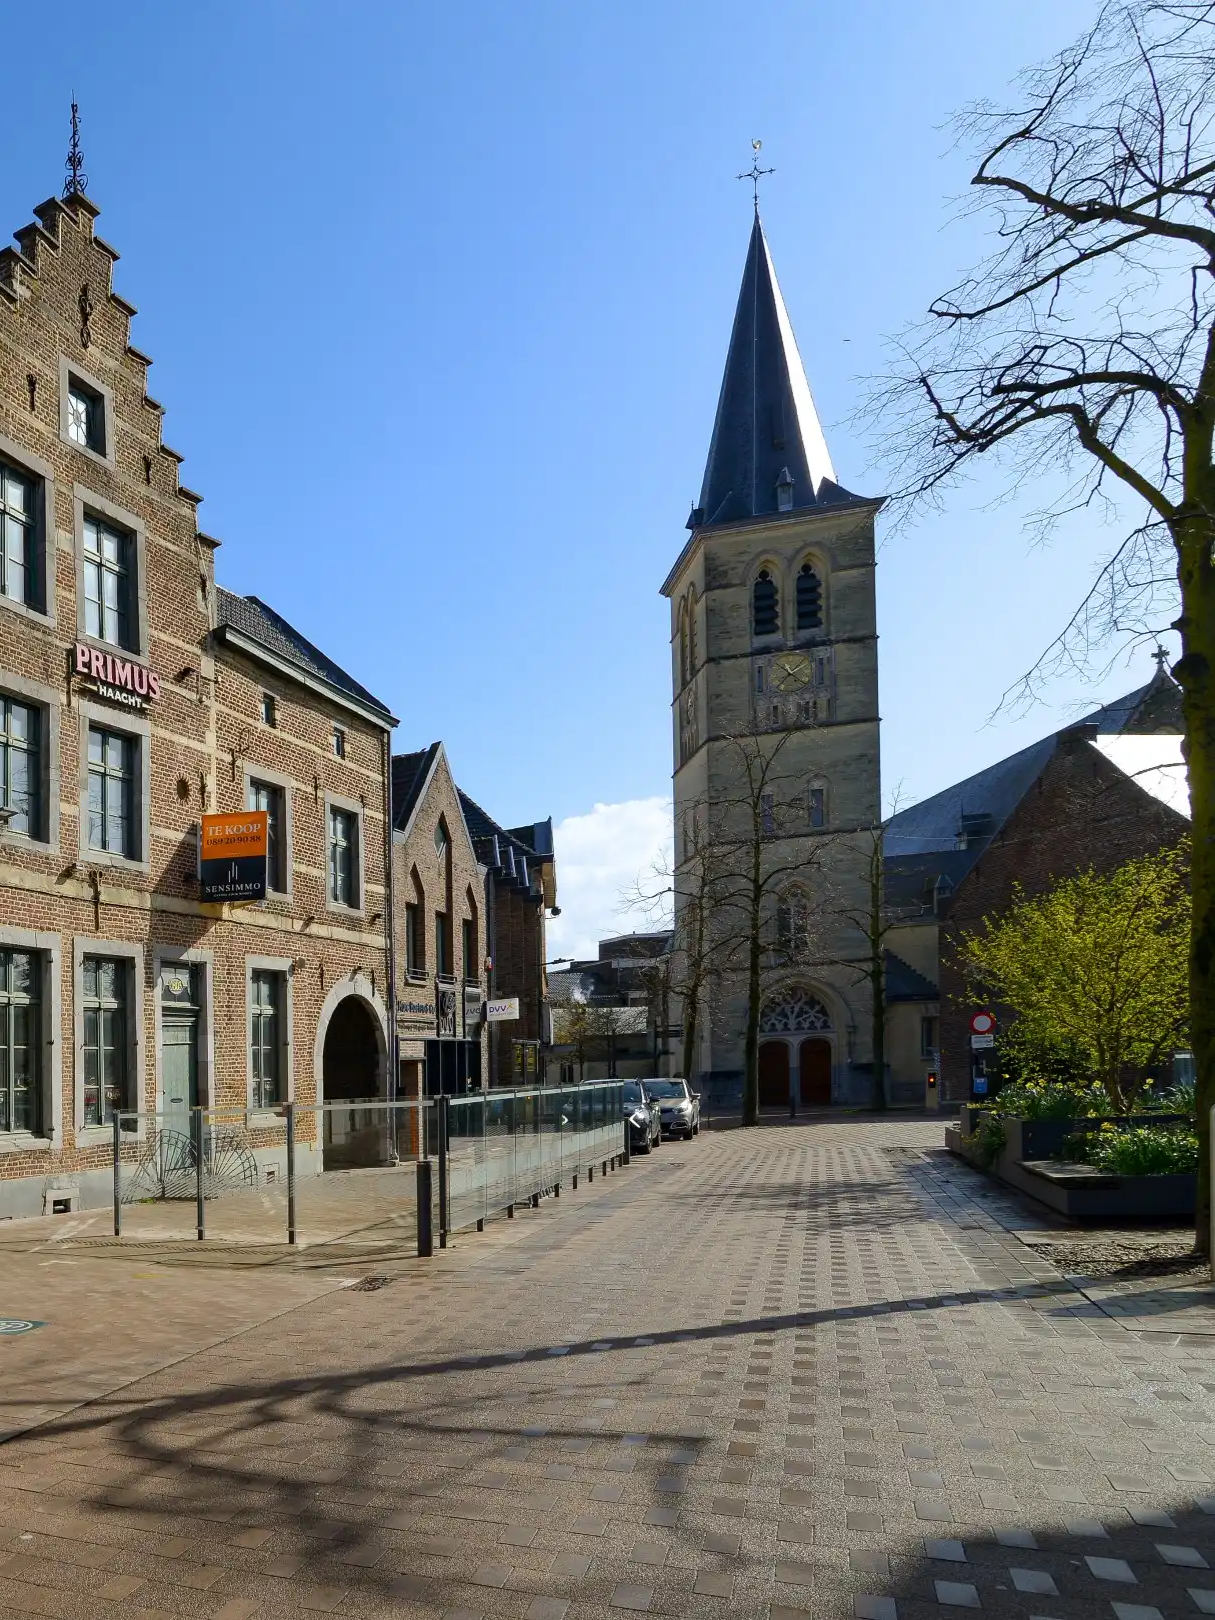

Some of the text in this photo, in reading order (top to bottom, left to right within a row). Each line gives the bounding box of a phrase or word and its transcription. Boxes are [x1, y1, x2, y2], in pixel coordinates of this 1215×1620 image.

[74, 642, 160, 699] PRIMUS
[98, 684, 142, 708] HAACHT
[207, 824, 261, 836] TE KOOP
[206, 838, 223, 846] 089
[224, 837, 235, 845] 20
[236, 836, 248, 844] 90
[205, 882, 261, 893] SENSIMMO
[489, 1004, 506, 1013] DVV
